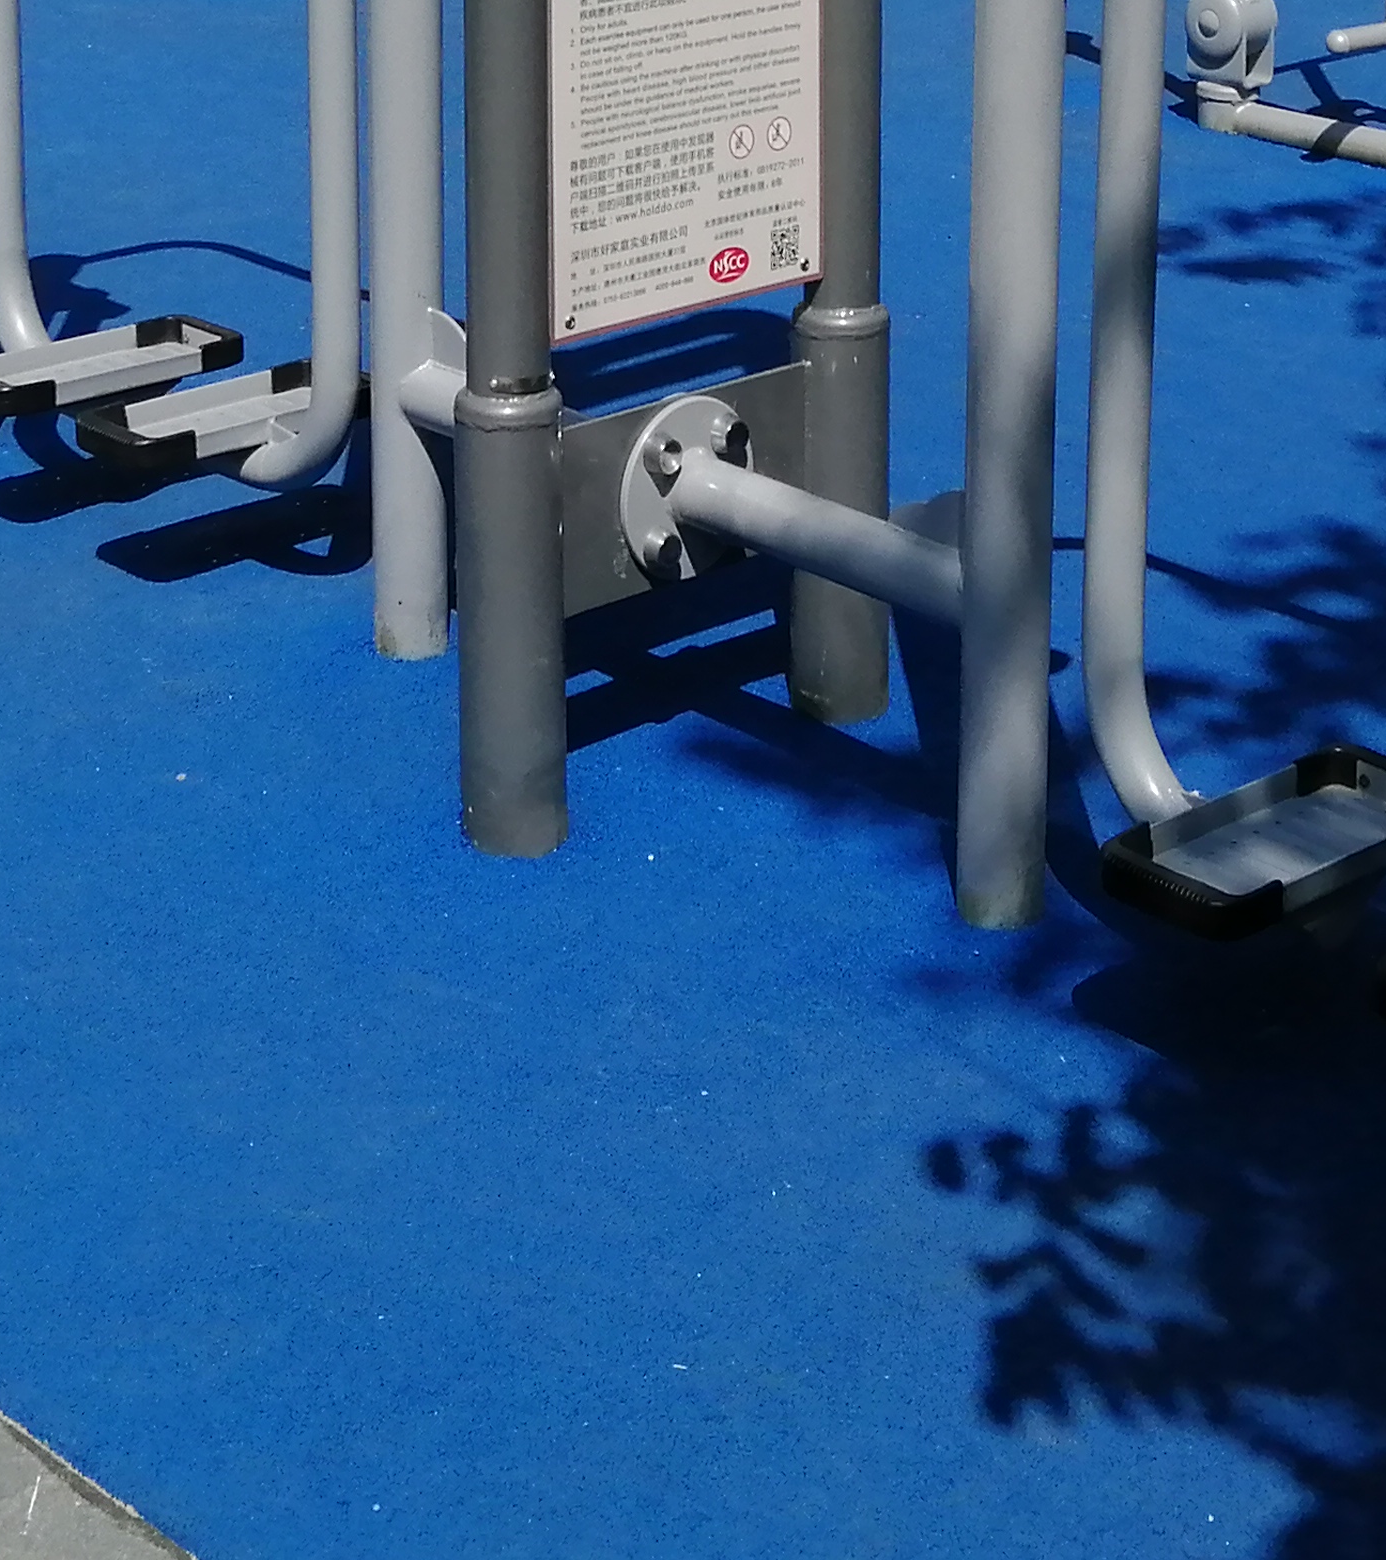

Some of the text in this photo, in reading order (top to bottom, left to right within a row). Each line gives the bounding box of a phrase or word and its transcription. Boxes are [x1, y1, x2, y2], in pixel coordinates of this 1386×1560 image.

[571, 224, 688, 263] 深圳市好家庭实业有限公司
[713, 252, 745, 275] NSCC
